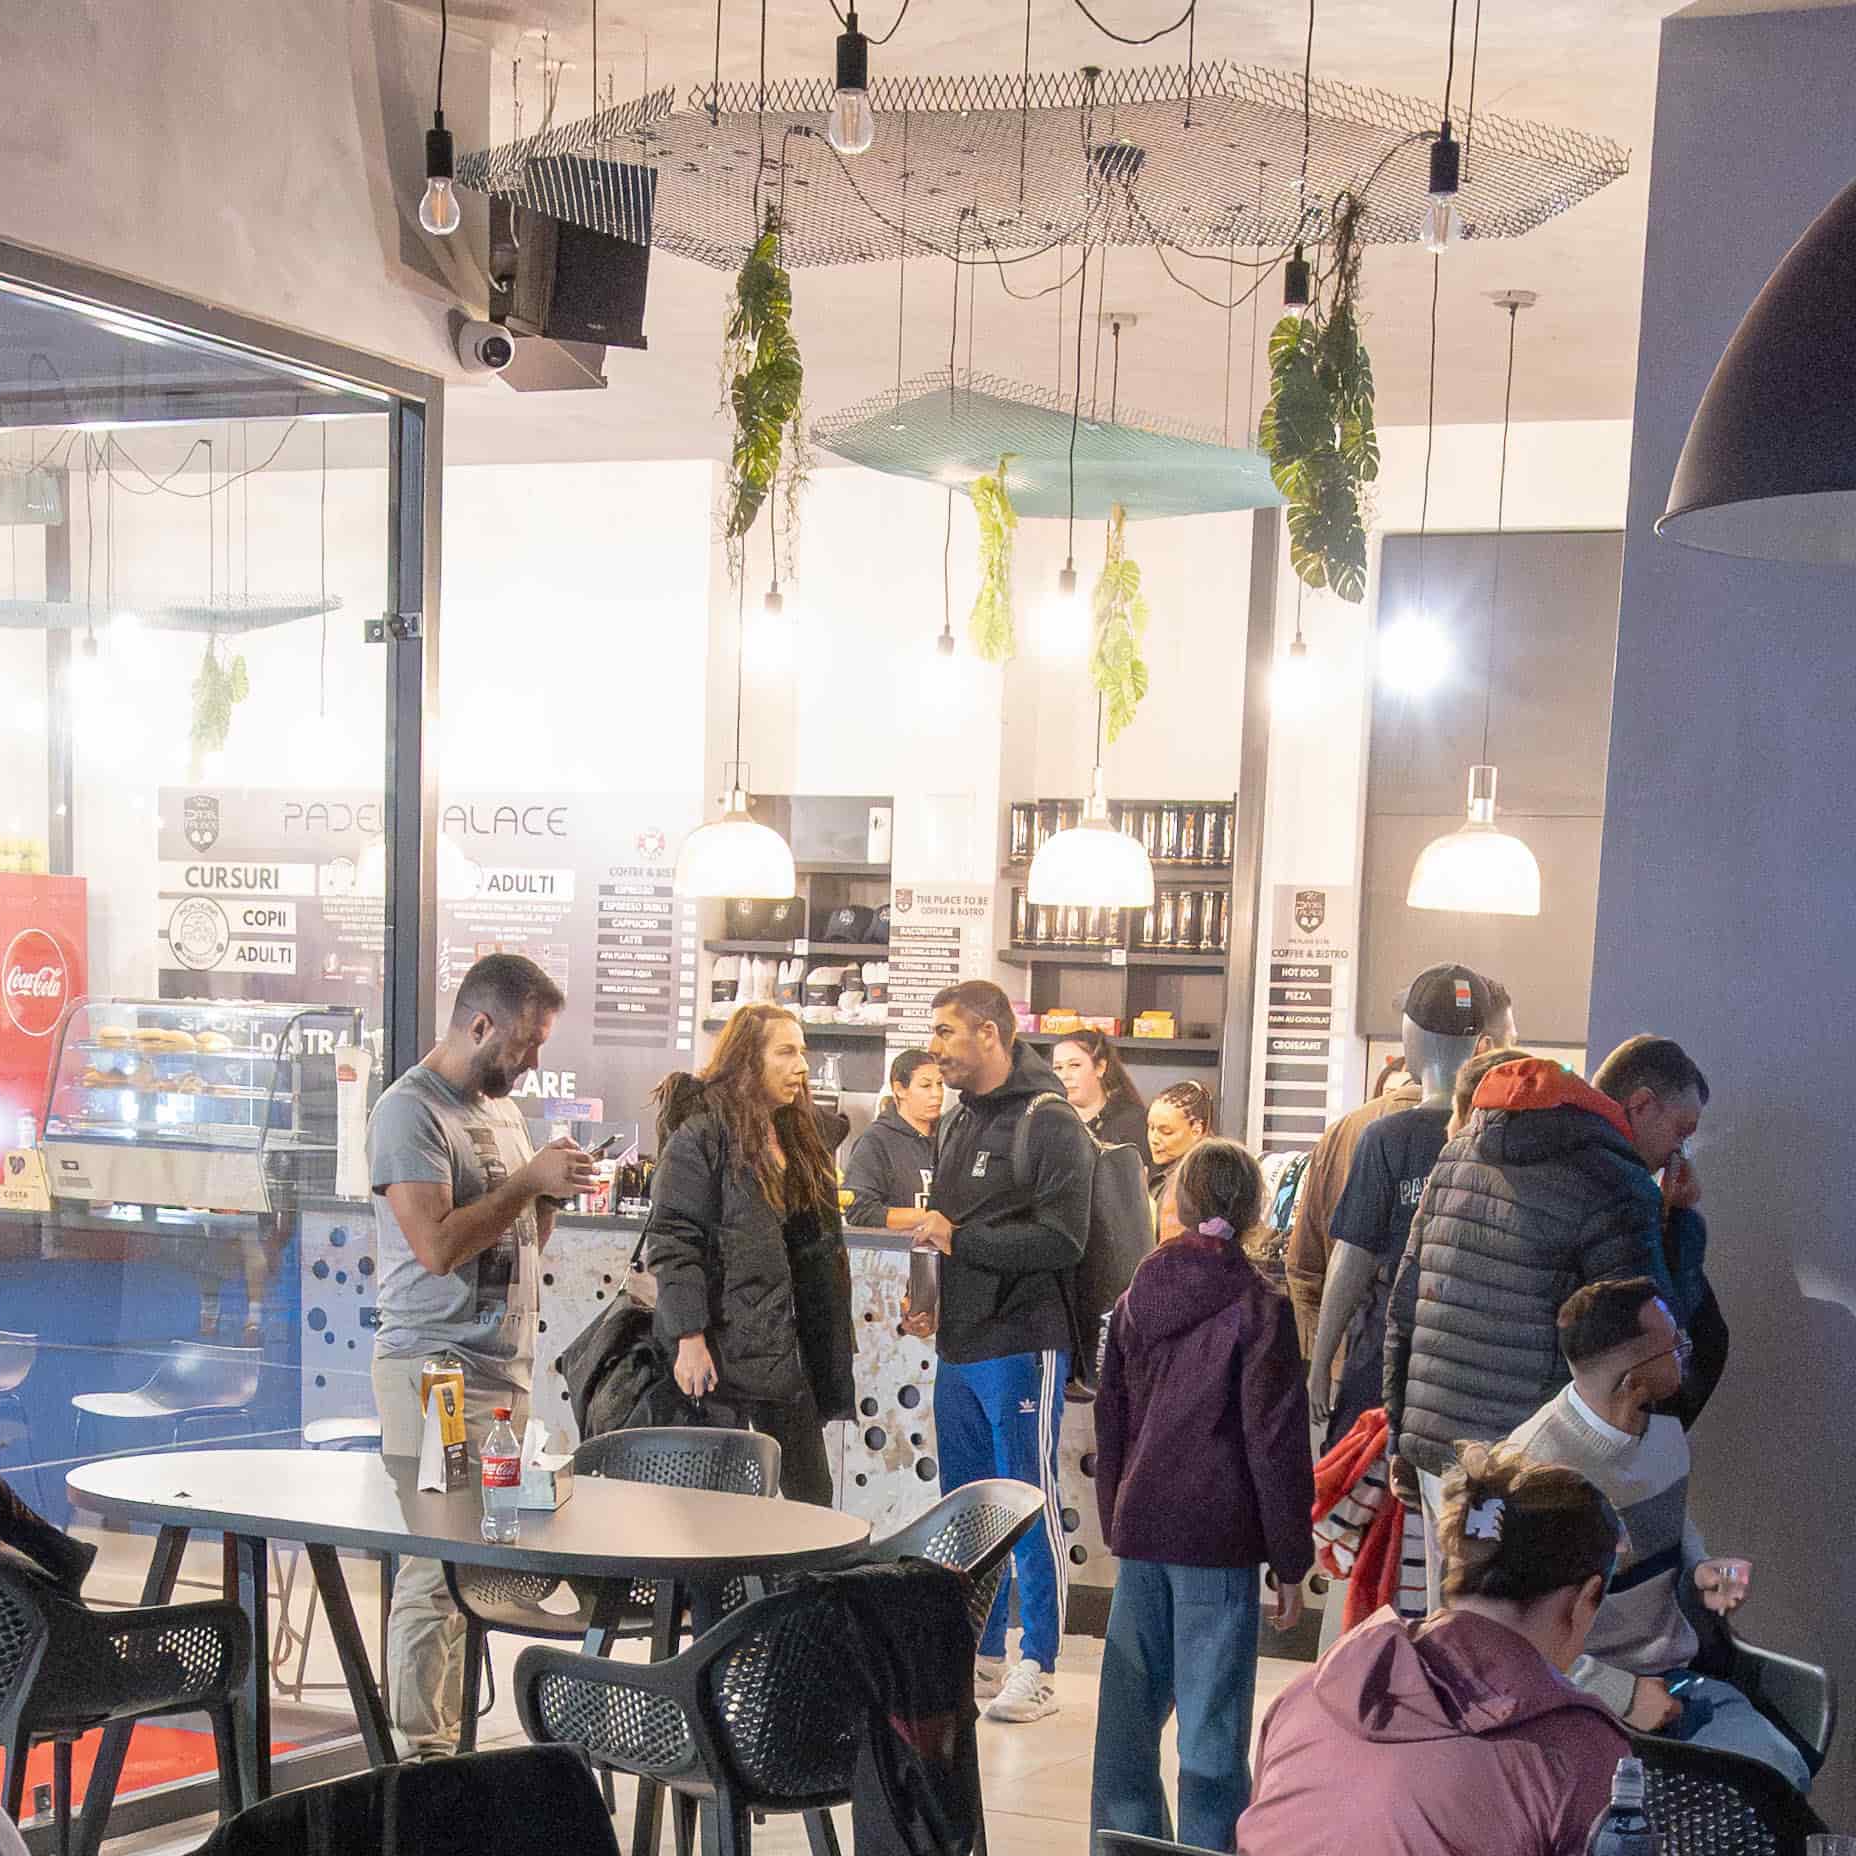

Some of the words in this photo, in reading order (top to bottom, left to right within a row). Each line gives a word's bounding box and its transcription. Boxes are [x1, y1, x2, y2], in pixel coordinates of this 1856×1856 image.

[443, 805, 568, 836] ALACE
[184, 867, 279, 889] CURSURI
[487, 874, 555, 894] ADULTI
[243, 910, 286, 927] COPII
[235, 946, 292, 964] ADULTI
[1271, 949, 1304, 958] COFFEE
[1316, 949, 1349, 959] BISTRO
[1281, 967, 1299, 977] HOT
[1300, 967, 1320, 978] DOG
[1284, 990, 1312, 1001] PIZZA
